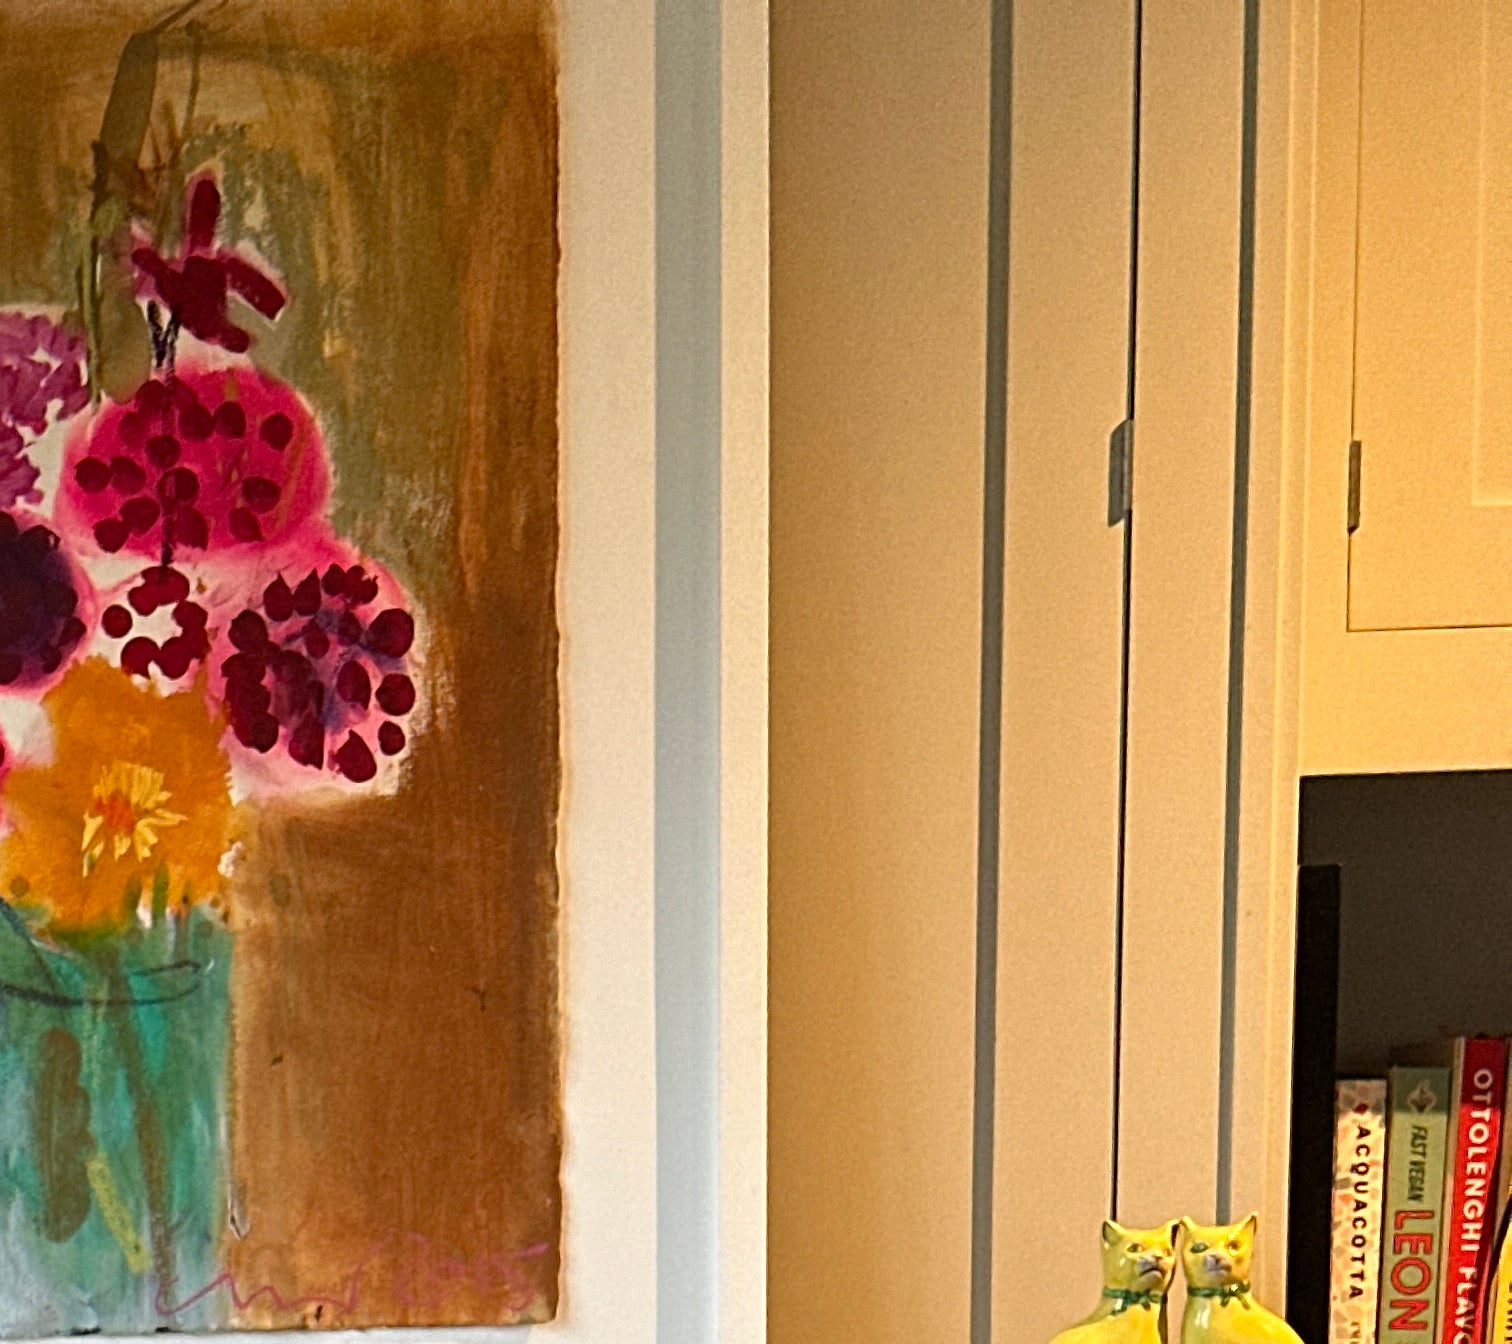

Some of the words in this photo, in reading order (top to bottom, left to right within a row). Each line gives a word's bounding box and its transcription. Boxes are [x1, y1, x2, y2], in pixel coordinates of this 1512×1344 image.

[1349, 1125, 1371, 1298] ACQUACOTTA
[1409, 1125, 1428, 1159] FAST
[1460, 1068, 1492, 1251] OTTOLENGHI
[1389, 1209, 1435, 1331] LEON
